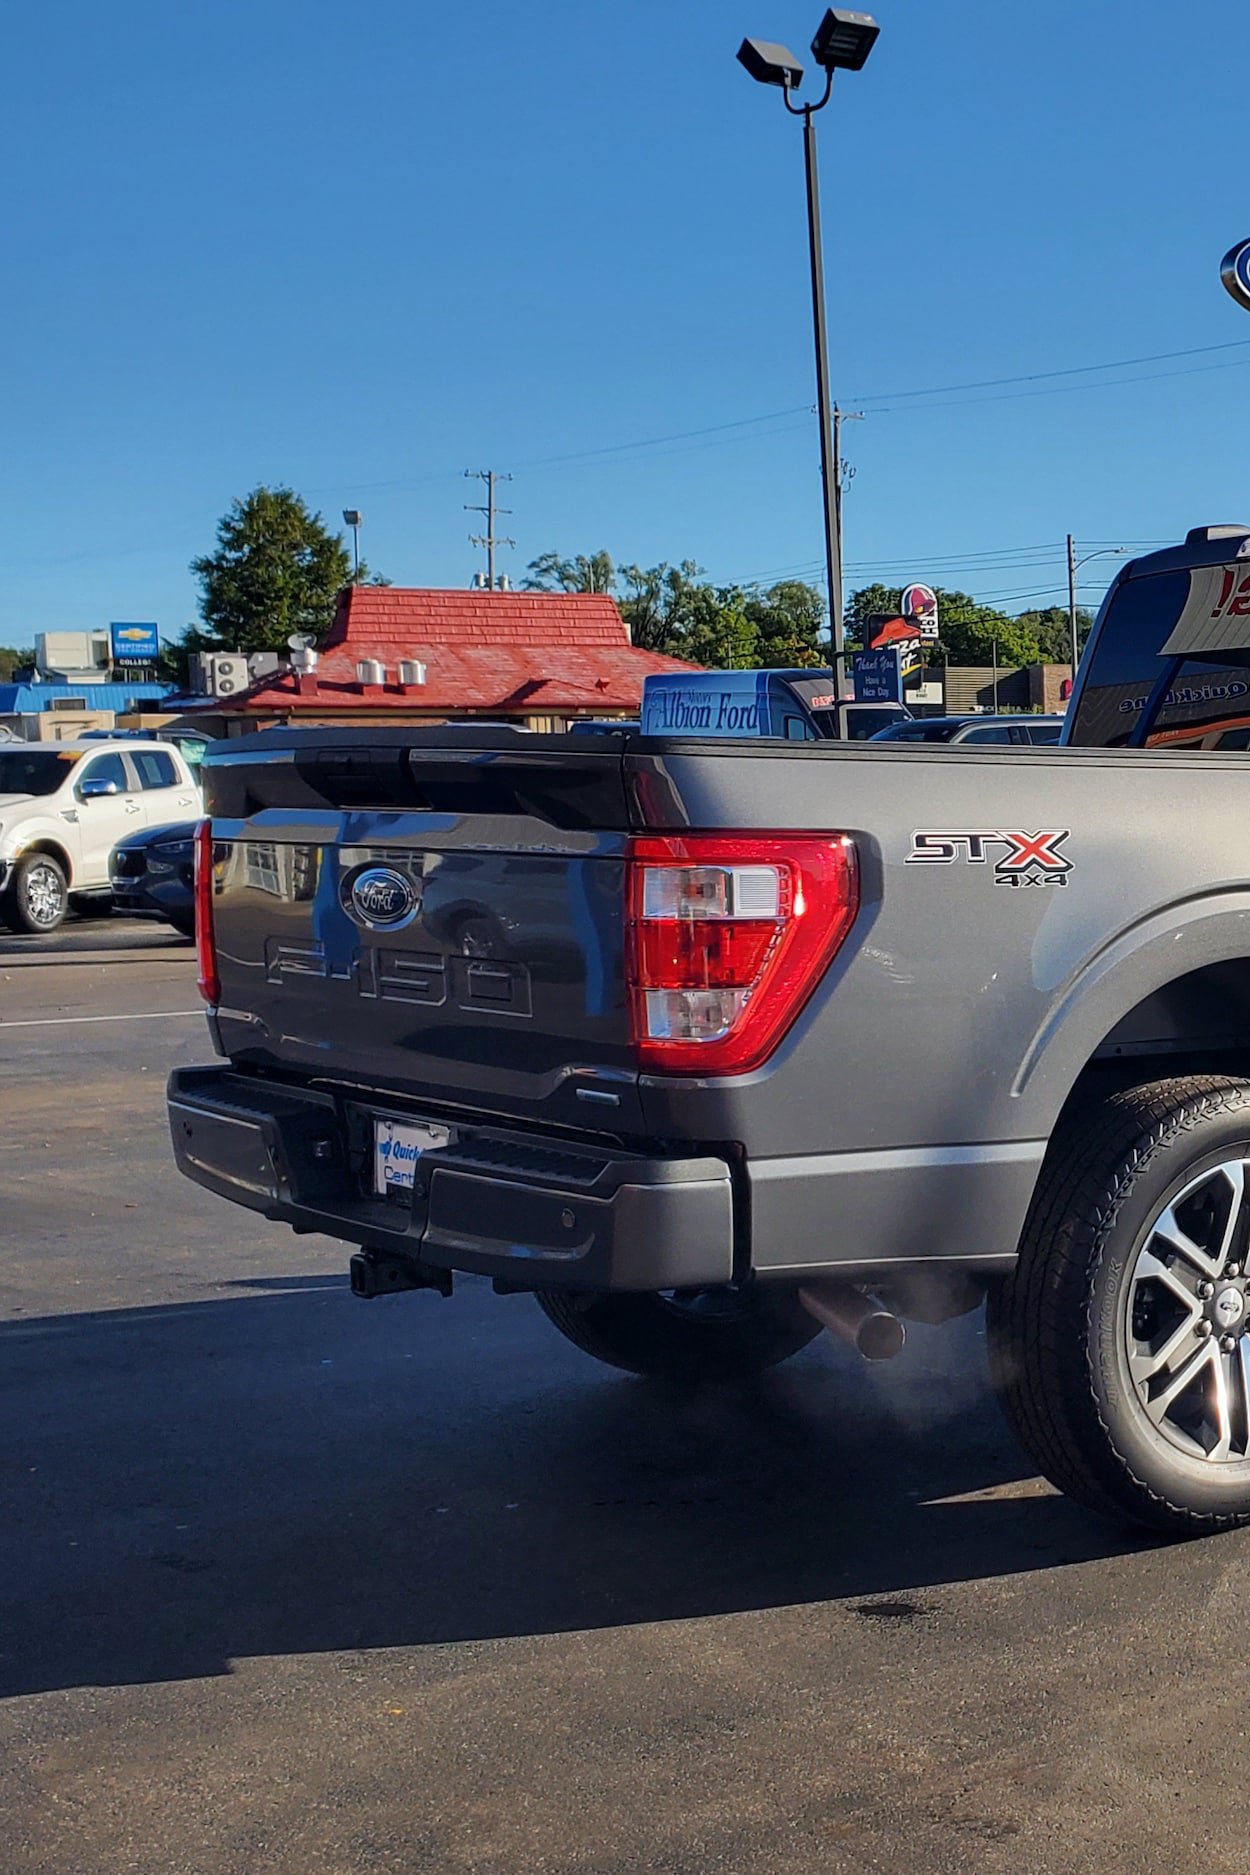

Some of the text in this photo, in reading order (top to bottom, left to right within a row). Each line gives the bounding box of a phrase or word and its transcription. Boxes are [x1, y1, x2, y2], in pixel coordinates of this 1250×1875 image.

[879, 655, 895, 672] You
[653, 688, 759, 729] Albion Ford
[904, 829, 1074, 874] STX
[360, 879, 395, 911] Ford
[393, 1140, 421, 1161] Quick
